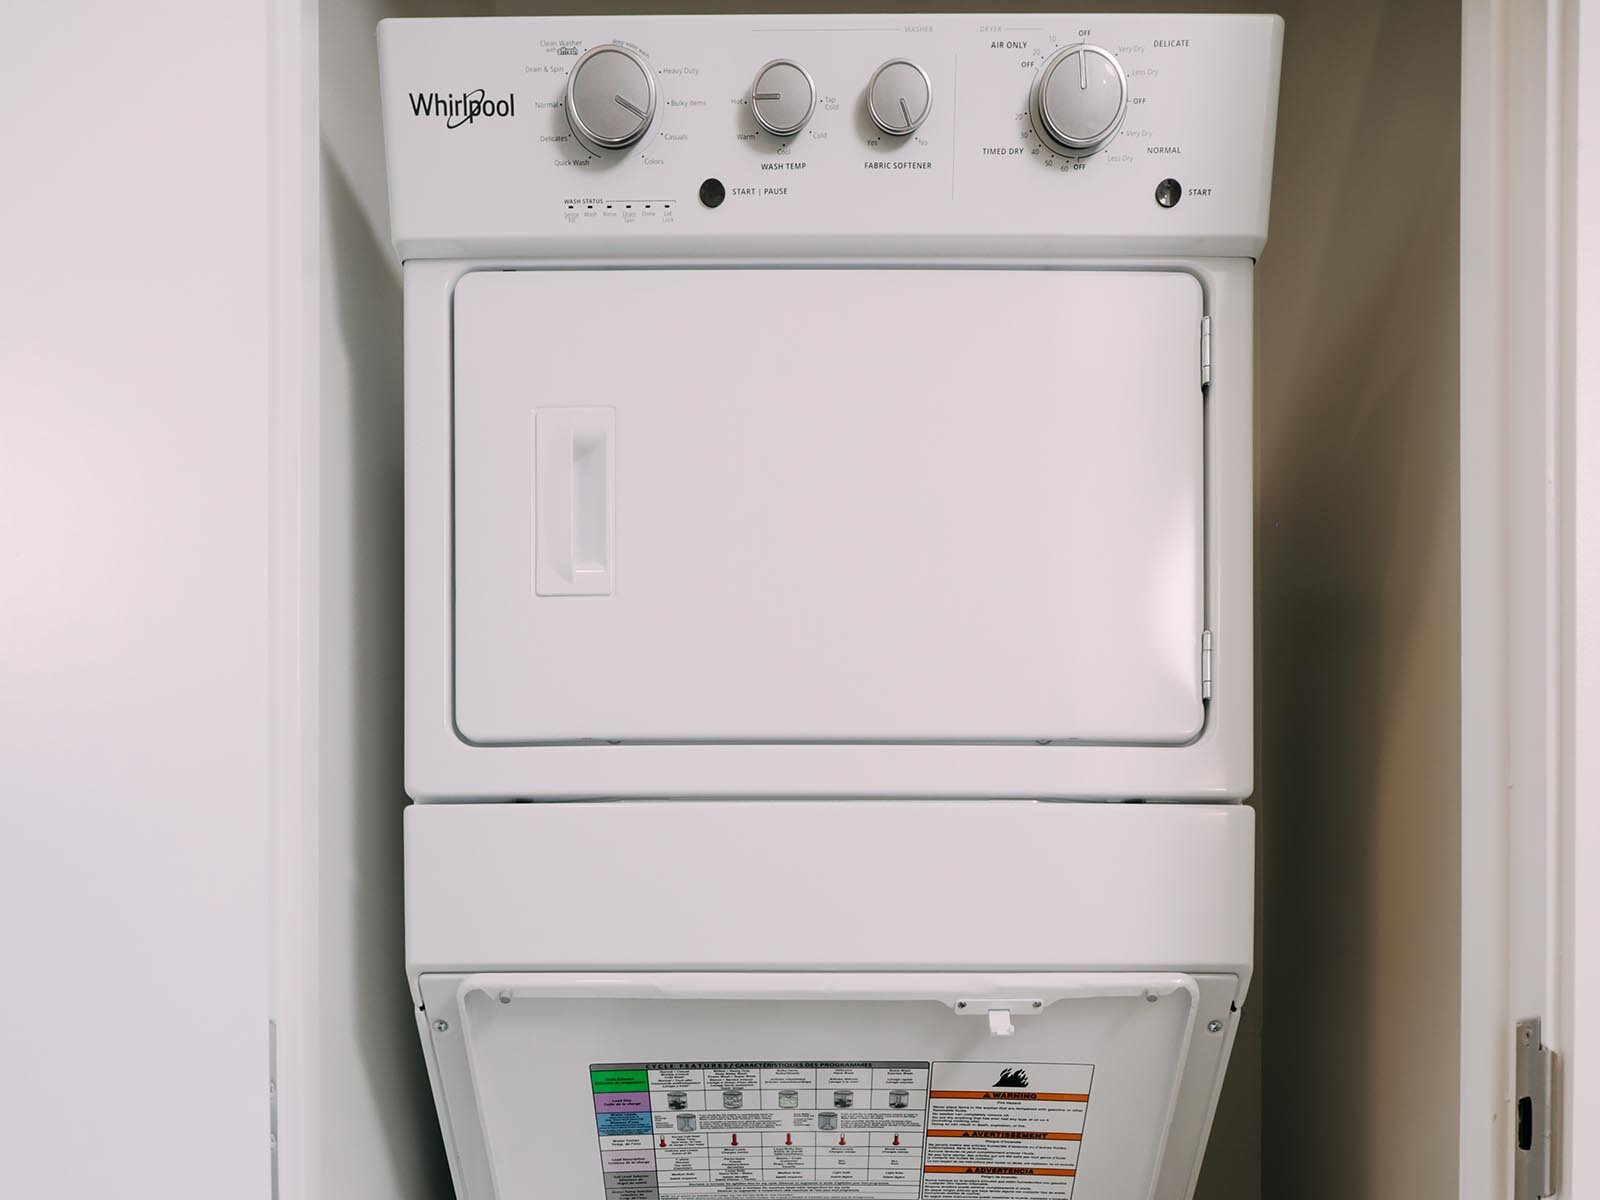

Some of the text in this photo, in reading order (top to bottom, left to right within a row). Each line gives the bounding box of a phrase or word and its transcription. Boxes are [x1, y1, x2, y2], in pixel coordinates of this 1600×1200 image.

[1007, 41, 1028, 49] ONLY
[1153, 40, 1190, 48] DELICATE
[550, 66, 564, 74] Spin
[671, 100, 688, 108] Bulky
[409, 89, 514, 129] Whirlpool
[554, 159, 571, 167] Quick
[972, 1131, 1048, 1139] AVERTISSEMENT
[975, 1167, 1034, 1175] ADVERTENCIA
